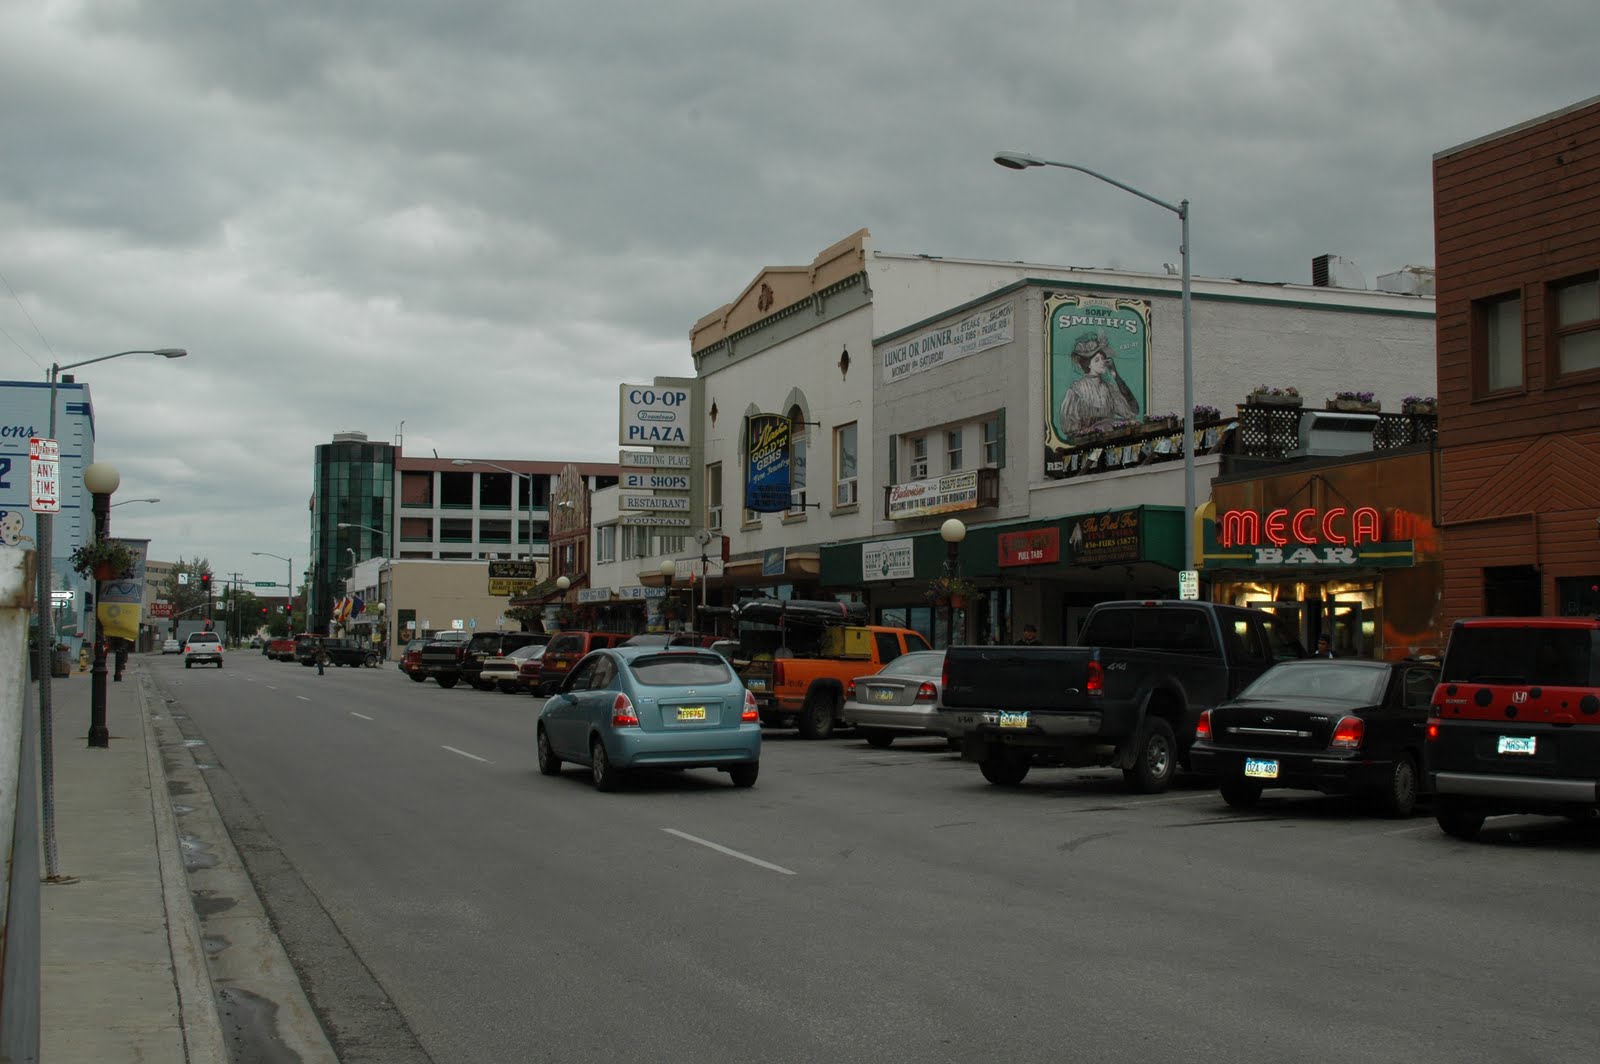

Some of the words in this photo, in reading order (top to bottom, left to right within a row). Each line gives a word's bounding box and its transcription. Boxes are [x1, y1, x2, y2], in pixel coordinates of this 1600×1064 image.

[1085, 308, 1113, 317] SOAPY
[960, 317, 980, 333] STEAKS
[965, 329, 977, 341] RIBS
[981, 322, 997, 336] PRIME
[998, 318, 1008, 329] RIB
[1058, 314, 1138, 335] SMITH'S
[885, 347, 907, 367] LUNCH
[908, 342, 920, 358] OR
[922, 329, 952, 354] DINNER
[891, 362, 911, 378] MONDAY
[919, 350, 944, 368] SATURDAY
[629, 390, 687, 407] CO-OP
[629, 425, 685, 442] PLAZA
[31, 442, 39, 456] NO
[39, 446, 58, 456] PARKING
[633, 454, 665, 466] MEETING
[668, 455, 689, 466] PLACE
[757, 448, 782, 471] GEMS
[37, 464, 54, 478] ANY
[36, 481, 55, 495] TIME
[628, 475, 644, 487] 21
[650, 475, 687, 488] SHOPS
[891, 485, 926, 502] Budweiser
[891, 501, 906, 512] WELCOME
[914, 499, 919, 508] TO
[936, 495, 941, 505] OF
[968, 489, 976, 501] SUN
[628, 498, 687, 509] RESTAURANT
[626, 517, 686, 526] FOUNTAIN
[1099, 514, 1120, 532] Red
[1223, 507, 1380, 548] MECCA
[1018, 552, 1030, 561] PULL
[1031, 550, 1043, 560] TABS
[1255, 547, 1358, 564] BAR
[1181, 573, 1186, 581] 2
[632, 588, 641, 597] 21
[644, 586, 667, 598] SHOPS
[1505, 740, 1521, 751] MRS
[1264, 764, 1277, 774] 480
